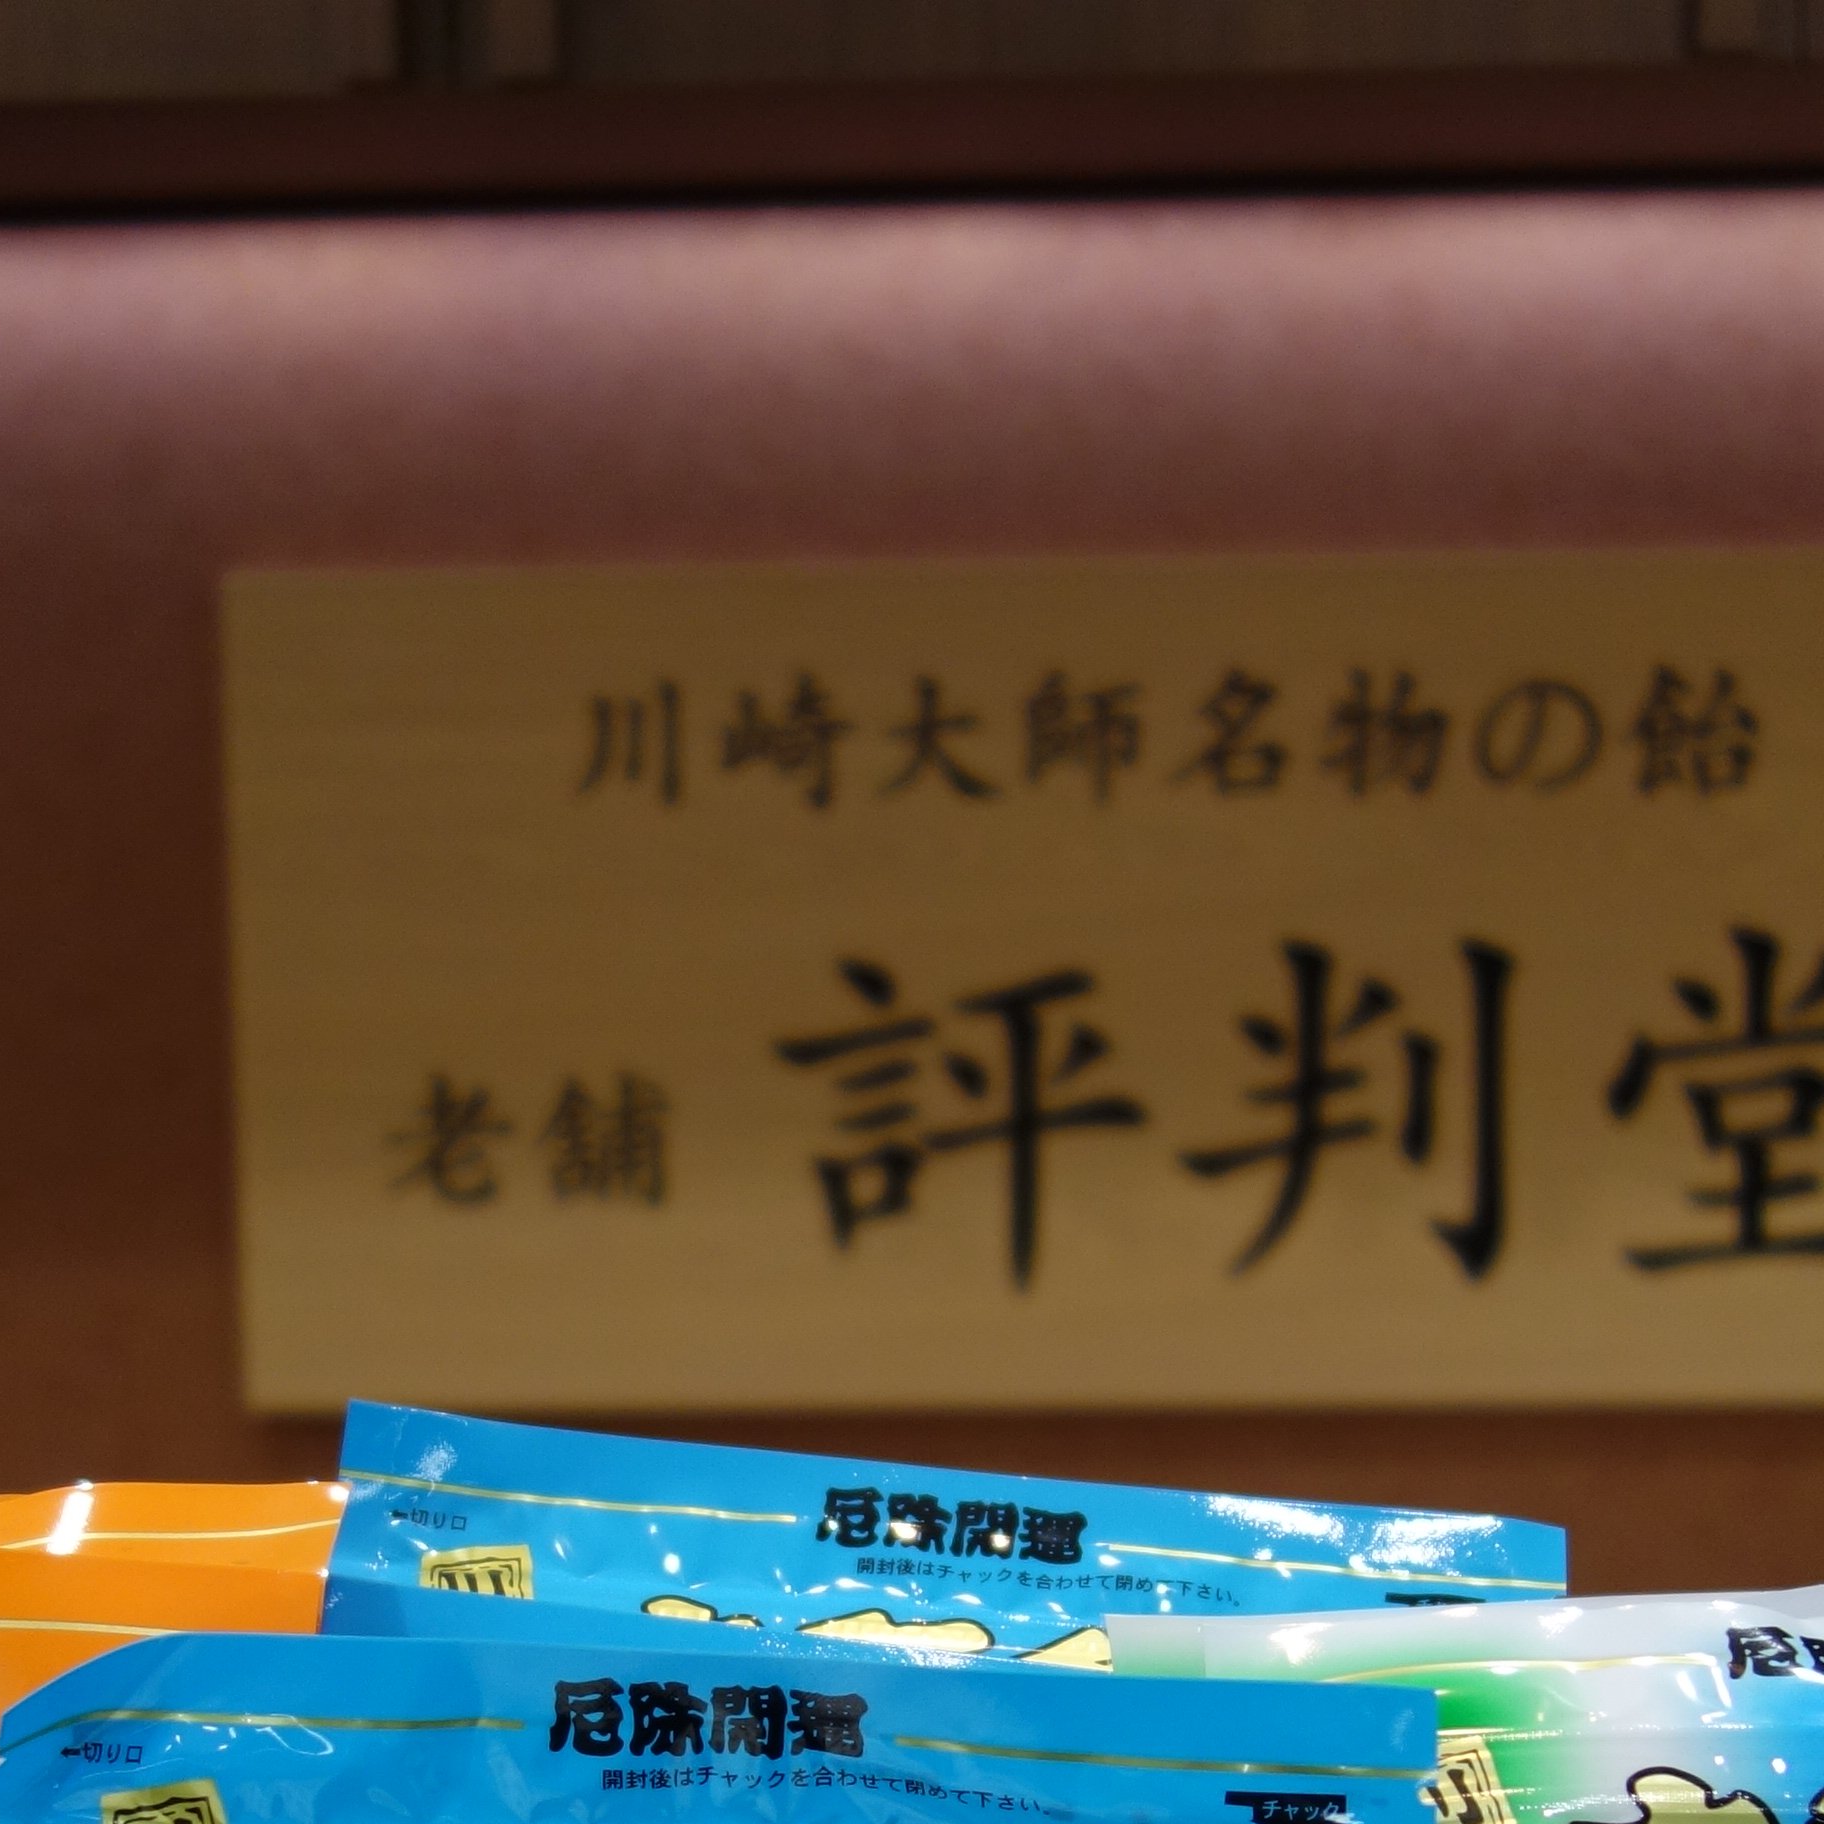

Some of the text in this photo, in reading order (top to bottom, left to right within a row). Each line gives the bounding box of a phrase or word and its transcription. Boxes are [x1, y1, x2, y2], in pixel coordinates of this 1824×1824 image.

[572, 660, 1762, 808] 川崎大師名物の飴
[384, 1070, 674, 1208] 老舗
[816, 1486, 1088, 1567] 厄除開運
[81, 1741, 144, 1765] 切り口
[548, 1678, 870, 1760] 厄除開運
[601, 1764, 1053, 1818] 開封後はチャックを合わせて閉めて下さい。
[1259, 1798, 1344, 1824] チャック
